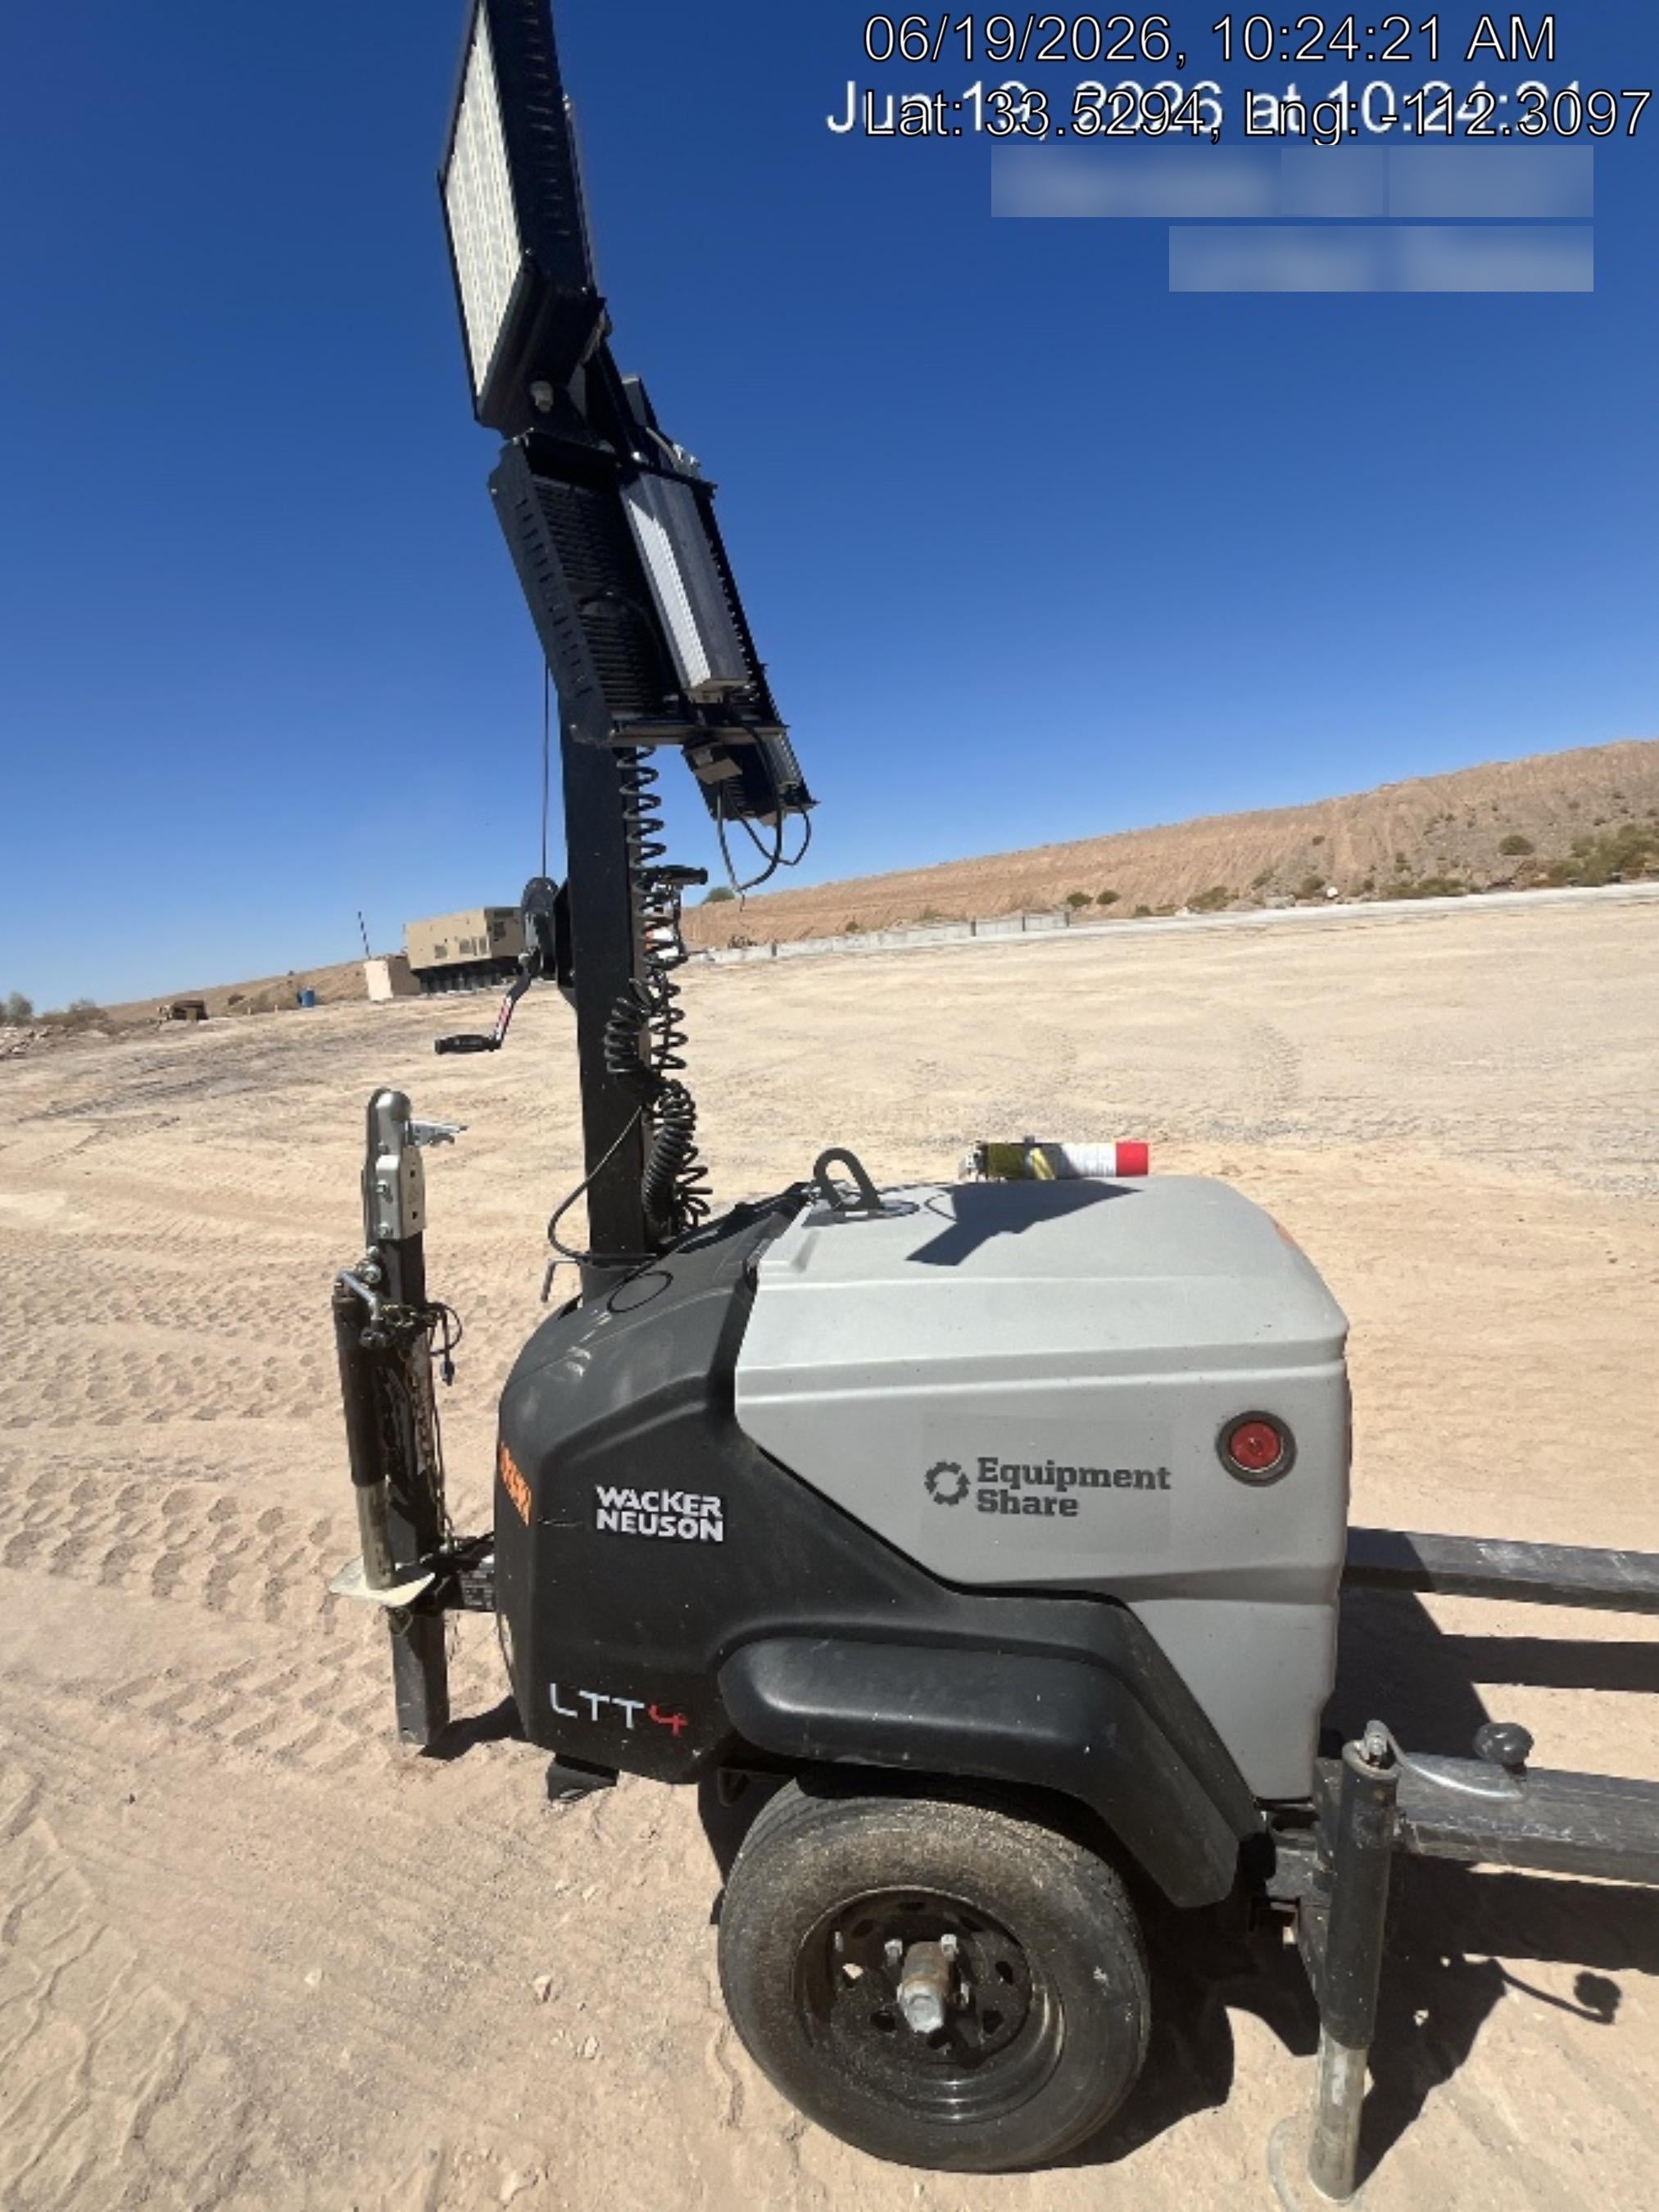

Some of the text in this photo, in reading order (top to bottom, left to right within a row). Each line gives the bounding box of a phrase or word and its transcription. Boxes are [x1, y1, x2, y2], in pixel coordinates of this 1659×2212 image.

[977, 1457, 1172, 1491] Equipment
[594, 1485, 722, 1517] WACKER
[977, 1489, 1079, 1517] Share
[596, 1508, 724, 1543] NEUSON
